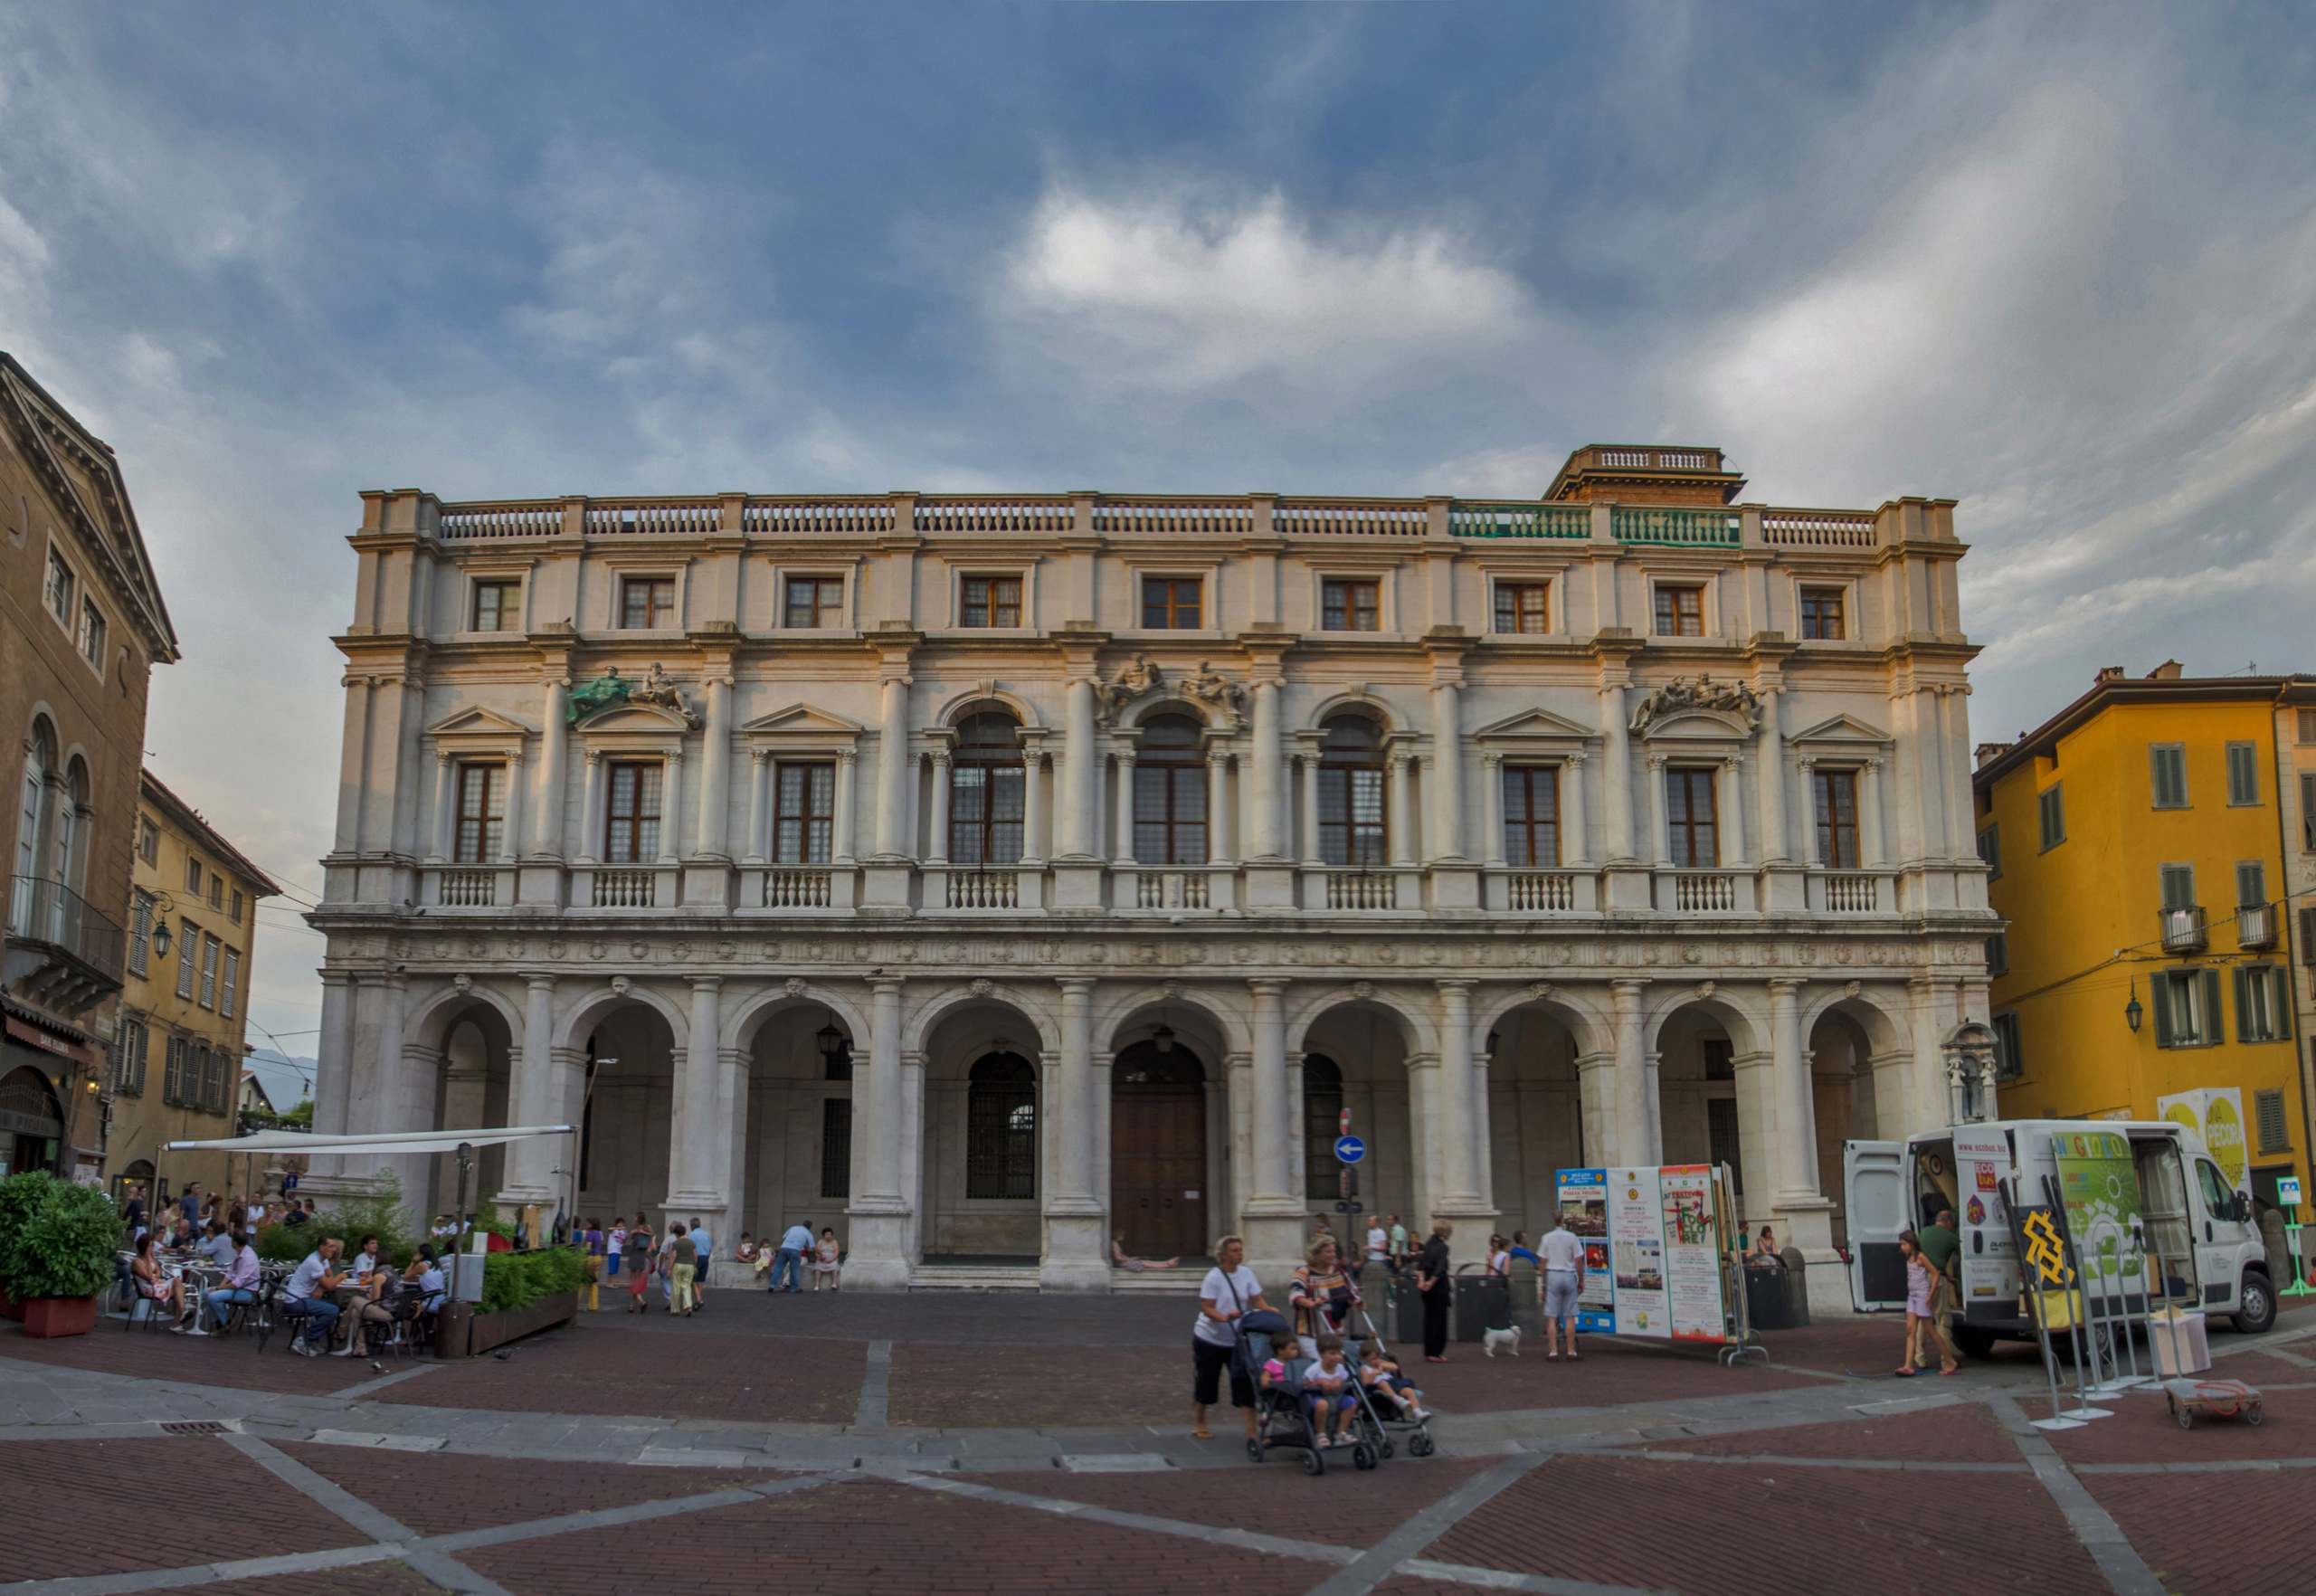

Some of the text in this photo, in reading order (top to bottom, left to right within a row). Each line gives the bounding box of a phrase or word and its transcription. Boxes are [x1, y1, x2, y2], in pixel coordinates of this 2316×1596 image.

[40, 1033, 52, 1048] BAR
[2206, 1105, 2223, 1124] UNA
[2207, 1123, 2244, 1146] PECORA
[1958, 1144, 2007, 1153] www.ecobus.biz
[2074, 1135, 2122, 1157] GIOCO
[1976, 1164, 1994, 1173] ECO
[1979, 1173, 1995, 1185] bus
[1682, 1223, 1705, 1234] CLO
[1683, 1233, 1699, 1244] RE
